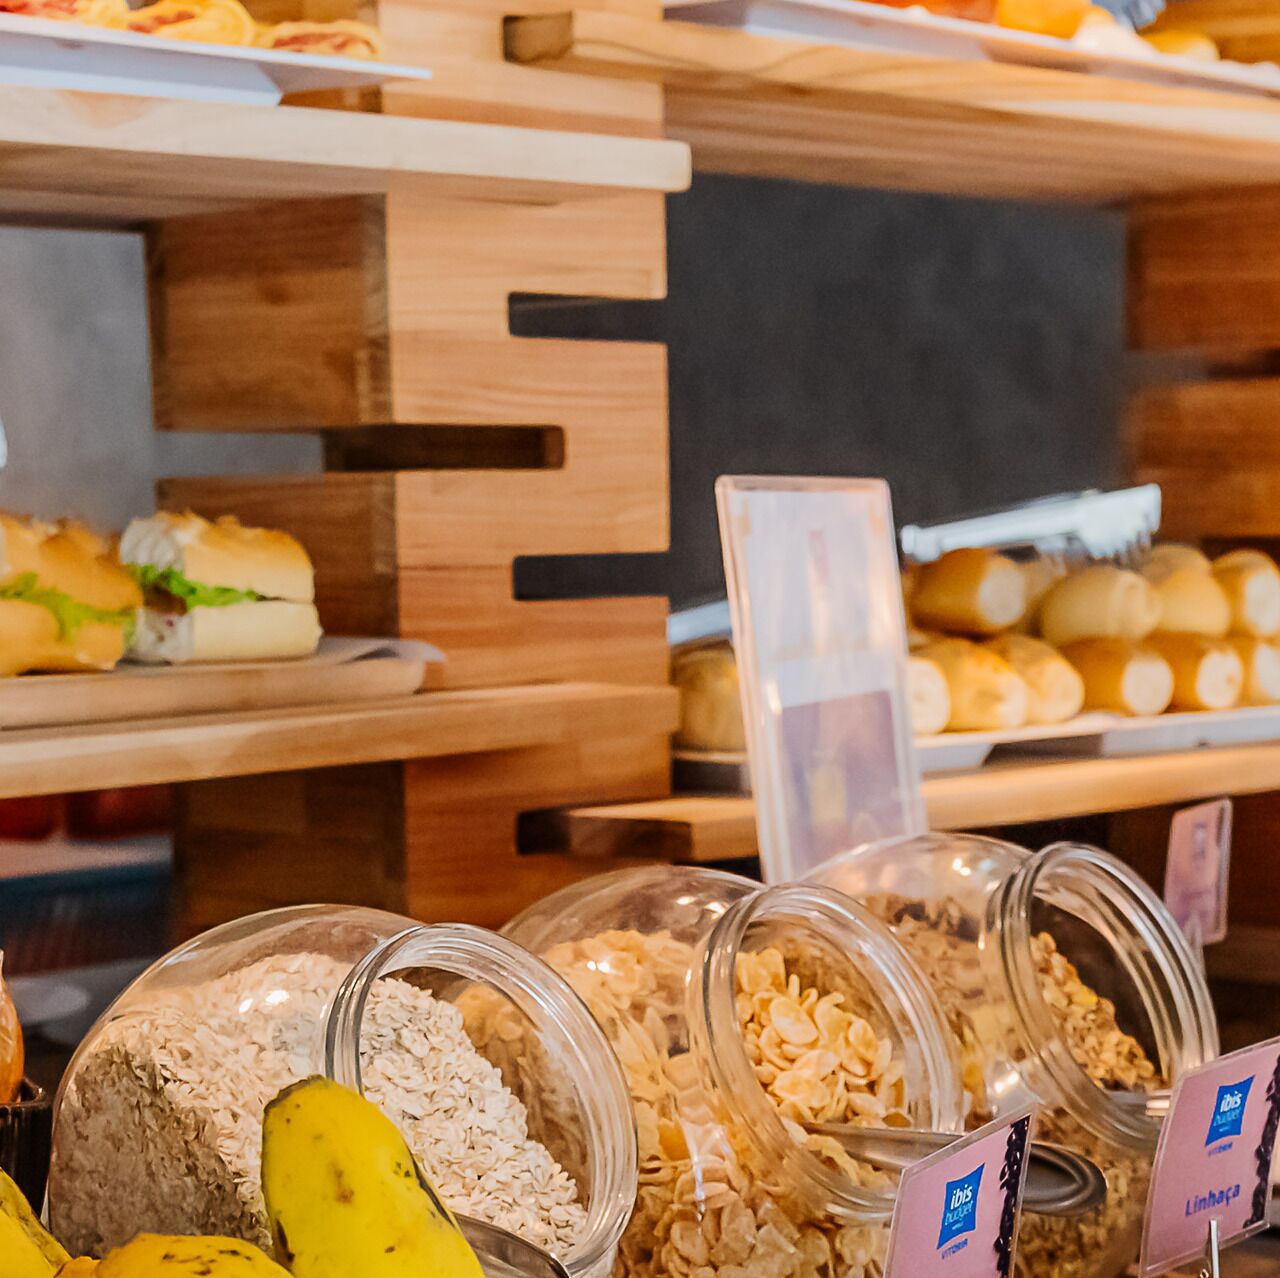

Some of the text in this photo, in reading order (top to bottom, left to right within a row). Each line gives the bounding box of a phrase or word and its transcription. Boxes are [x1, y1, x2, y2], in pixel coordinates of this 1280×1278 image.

[1220, 1091, 1243, 1113] ibis
[950, 1184, 973, 1209] ibis
[1185, 1184, 1241, 1217] Linhaça
[944, 1203, 973, 1226] budget
